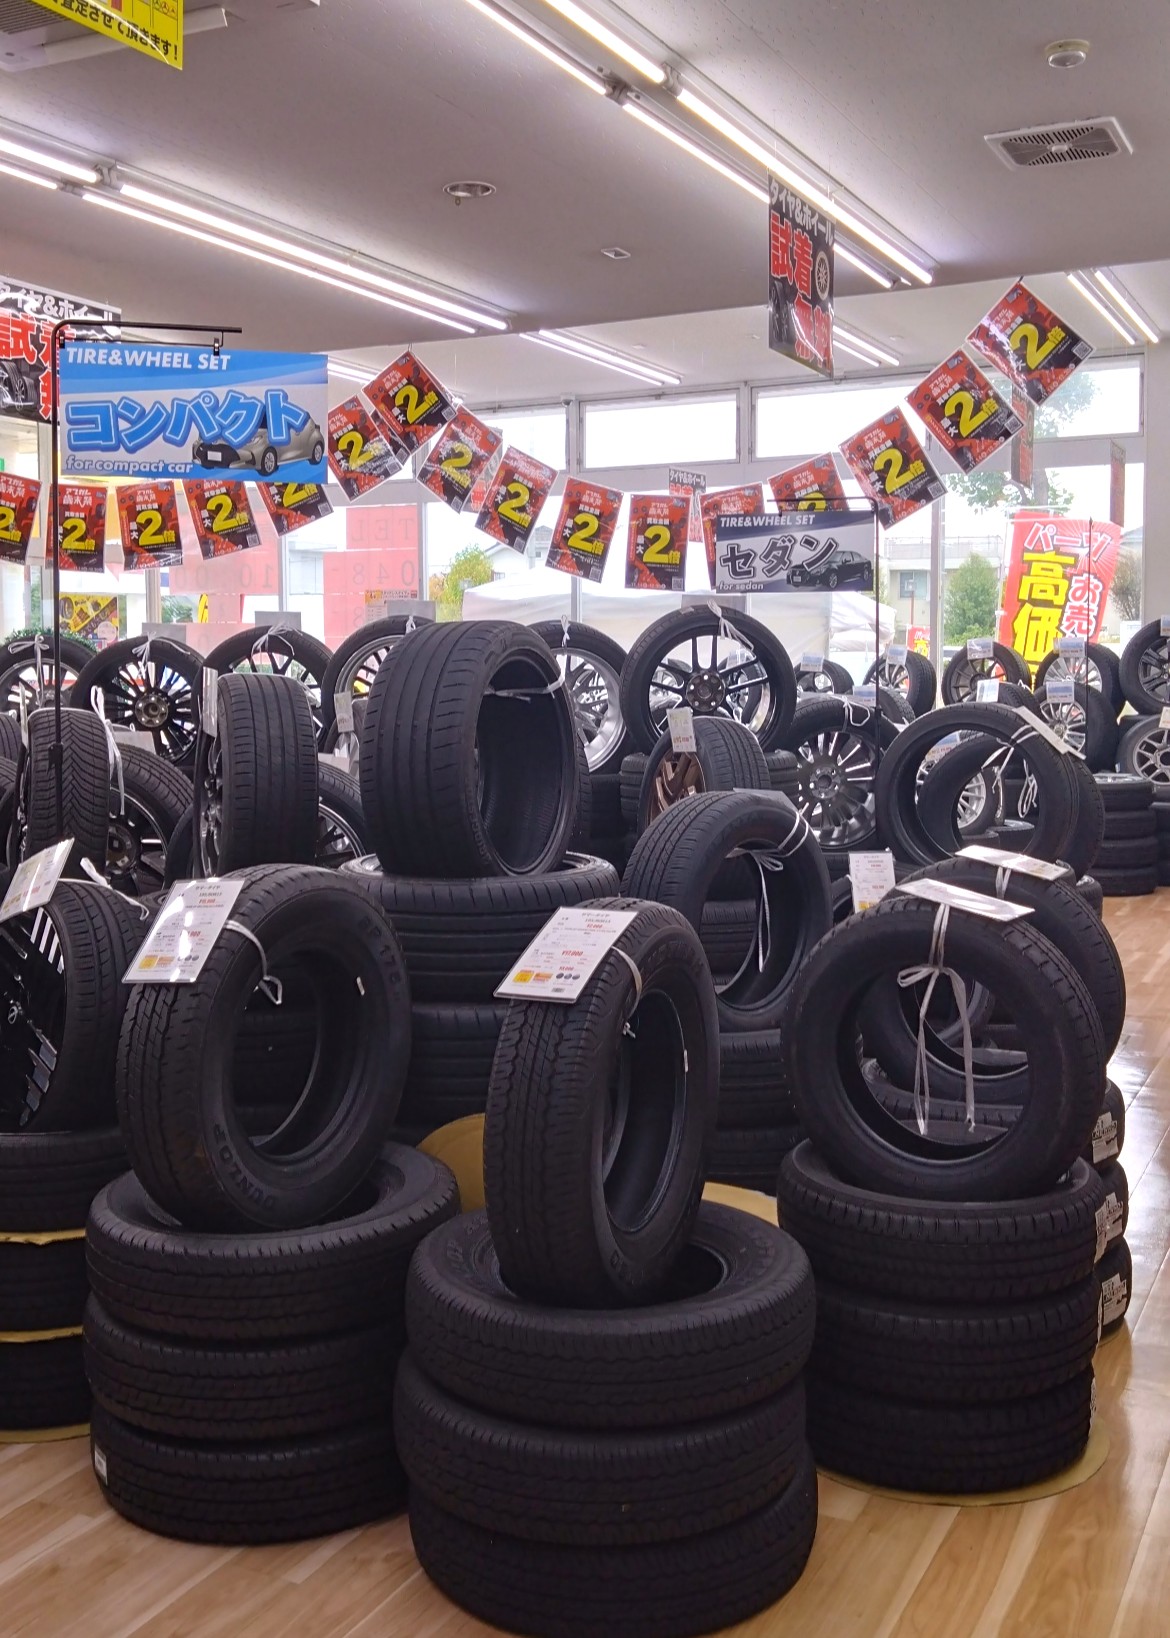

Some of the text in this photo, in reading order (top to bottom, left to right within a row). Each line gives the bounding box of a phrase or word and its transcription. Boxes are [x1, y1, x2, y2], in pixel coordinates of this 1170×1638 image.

[53, 0, 178, 60] 査定させて頂きます!
[769, 178, 834, 247] タイヤ&ホイール
[770, 210, 813, 300] 試着
[67, 347, 231, 371] TIRE&WHEEL SET
[1009, 322, 1066, 370] 2倍
[65, 389, 311, 454] コンパクト
[394, 384, 438, 425] 2倍
[944, 390, 1000, 438] 2倍
[66, 455, 193, 475] for compact car
[873, 447, 926, 495] 2倍
[206, 494, 250, 533] 2倍
[498, 481, 533, 529] 2倍
[720, 514, 816, 528] TIRE&WHEEL SET
[61, 518, 96, 551] 2倍
[135, 510, 176, 546] 2倍
[567, 512, 605, 556] 2倍
[642, 525, 681, 565] 2倍
[1023, 522, 1112, 562] パーツ
[719, 534, 838, 580] セダン
[719, 581, 764, 591] for sedan
